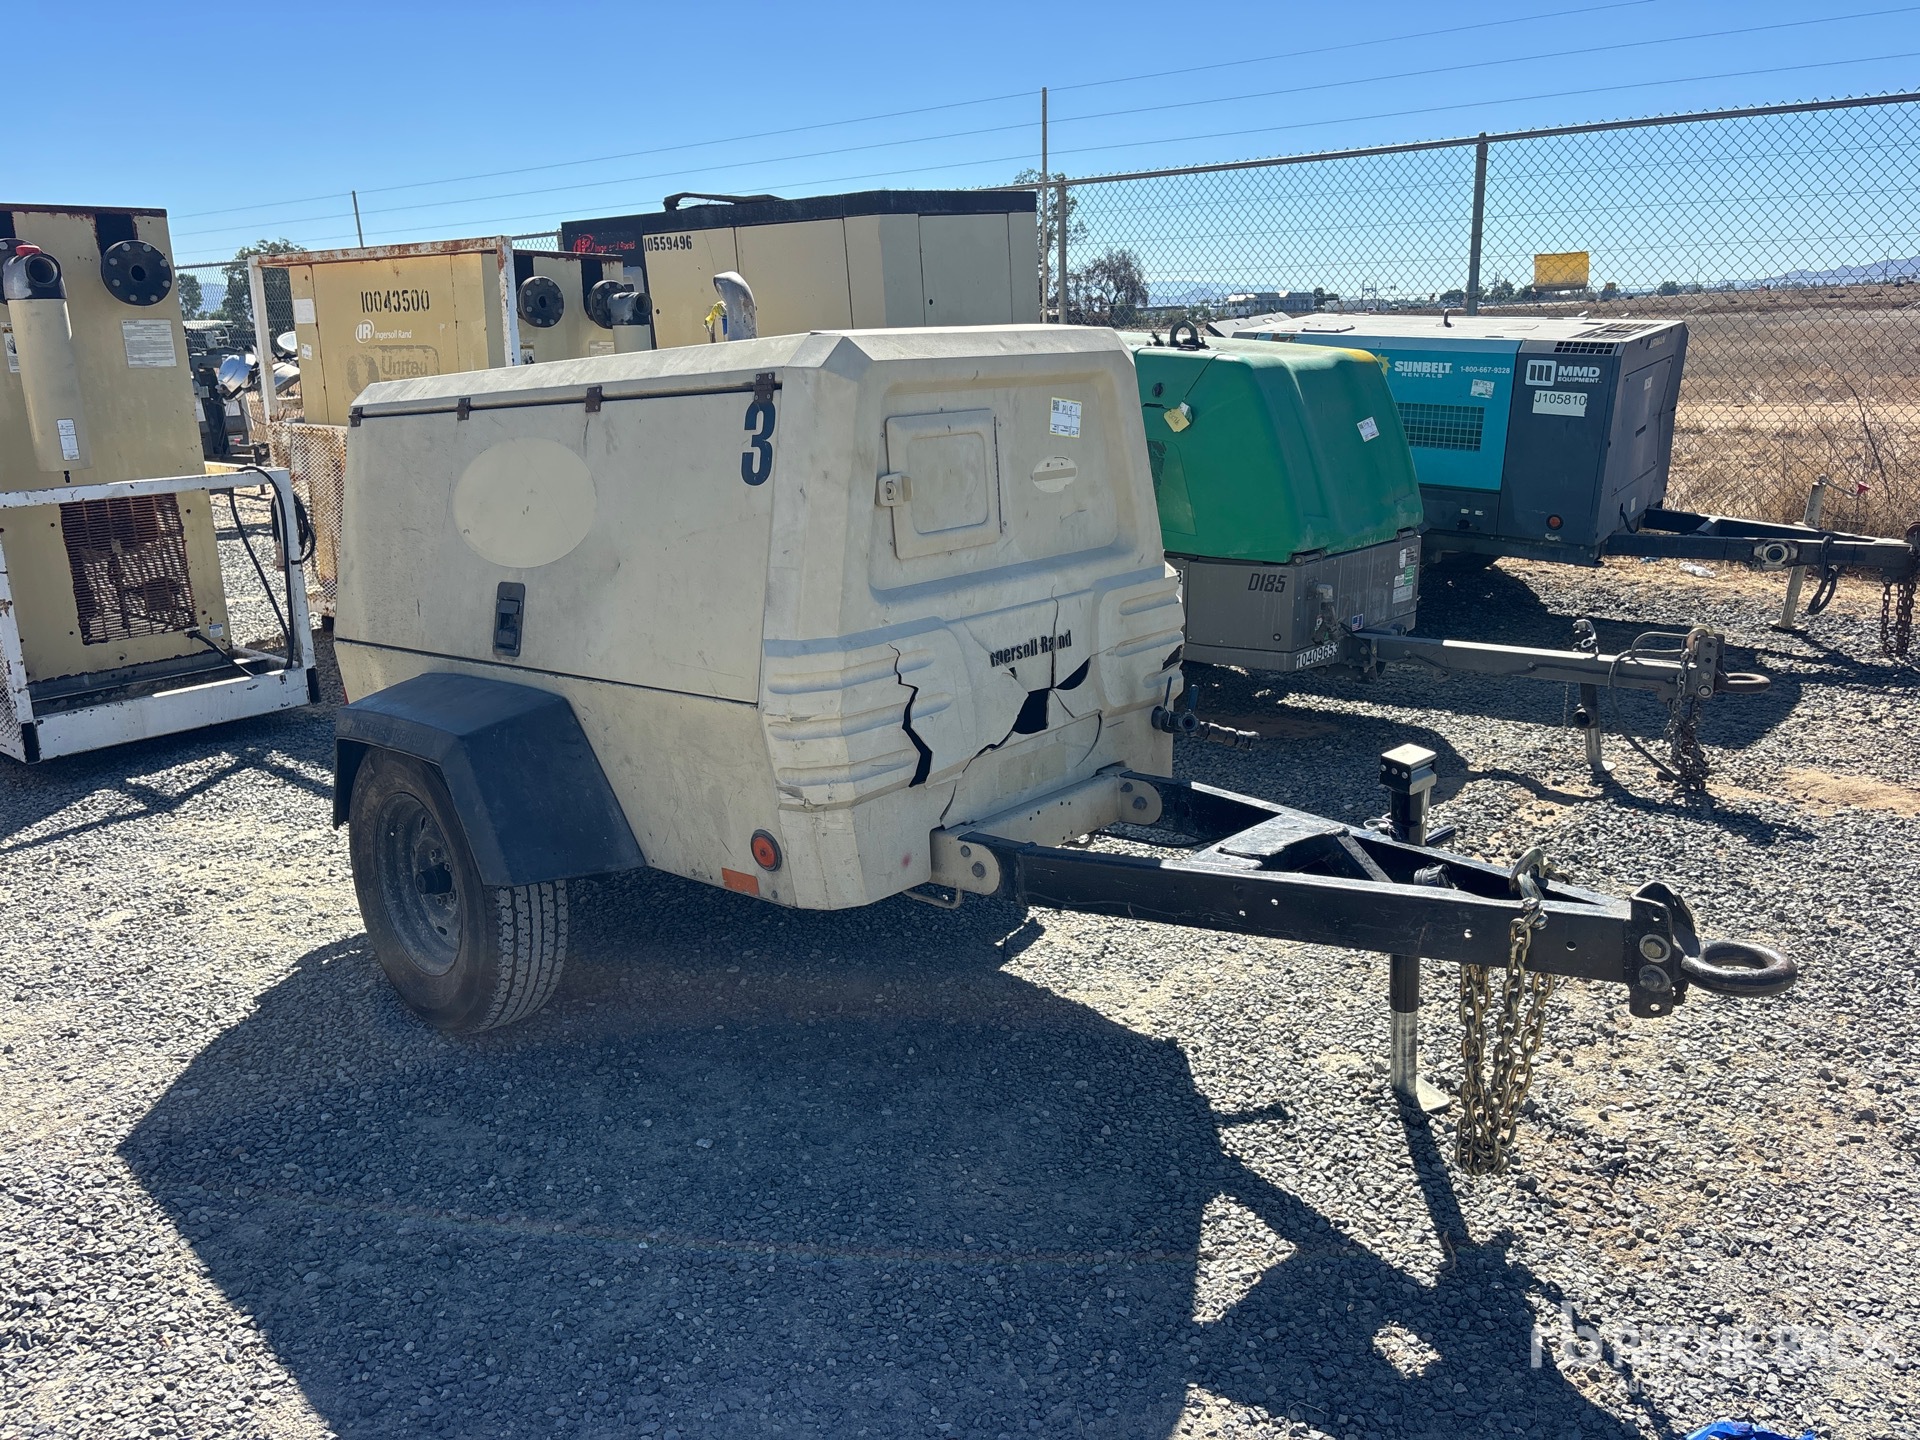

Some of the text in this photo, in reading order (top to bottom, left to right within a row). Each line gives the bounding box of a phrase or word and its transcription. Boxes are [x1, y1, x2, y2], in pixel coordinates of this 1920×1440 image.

[644, 235, 693, 252] 10559496
[360, 289, 430, 313] 10043500
[374, 329, 398, 341] Ingersoll
[398, 329, 412, 339] Rand
[1394, 361, 1511, 375] SUNBELT 1-800-667-9328
[1557, 365, 1601, 377] MMD
[1534, 391, 1587, 406] J105810
[740, 399, 772, 476] 3
[1247, 573, 1288, 593] D185
[1296, 642, 1338, 668] 10409653
